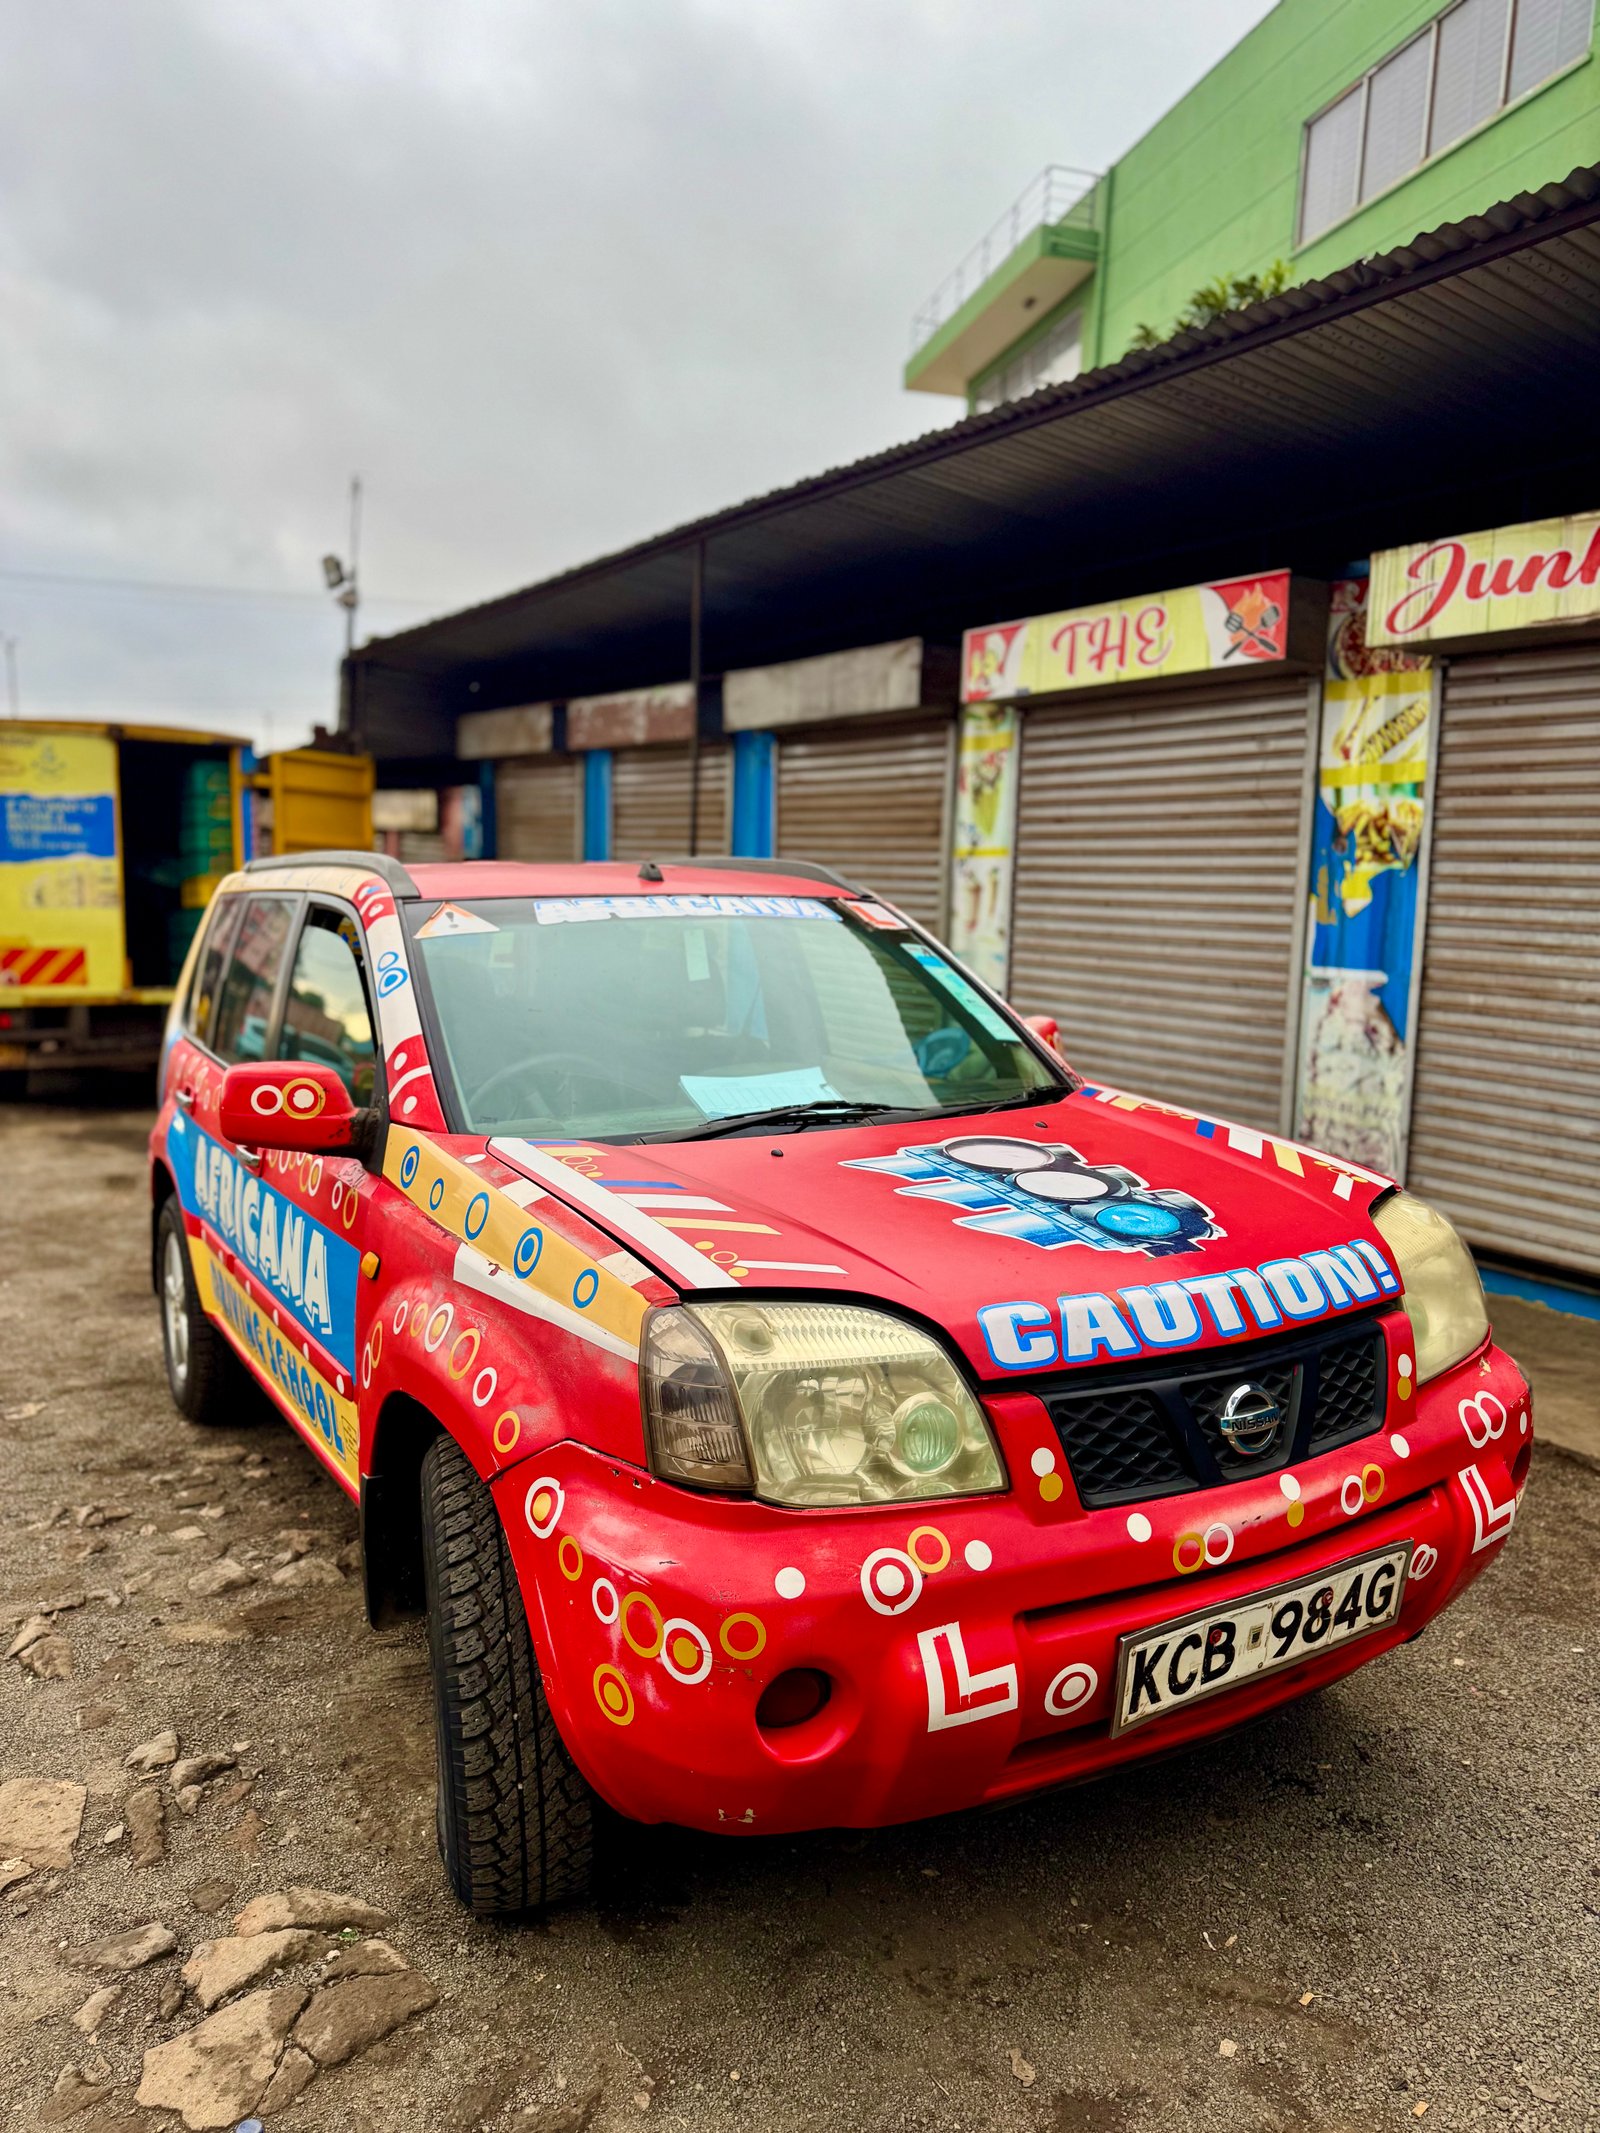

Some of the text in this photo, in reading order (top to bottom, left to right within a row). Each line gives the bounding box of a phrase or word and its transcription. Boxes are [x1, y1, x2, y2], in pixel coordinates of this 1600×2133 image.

[1050, 605, 1174, 677] THE
[195, 1133, 333, 1335] AFRICANA
[977, 1238, 1400, 1371] CAUTION!
[266, 1326, 346, 1461] SCHOOL
[1231, 1413, 1279, 1431] NISSAN
[1128, 1562, 1396, 1715] KCB 984G
